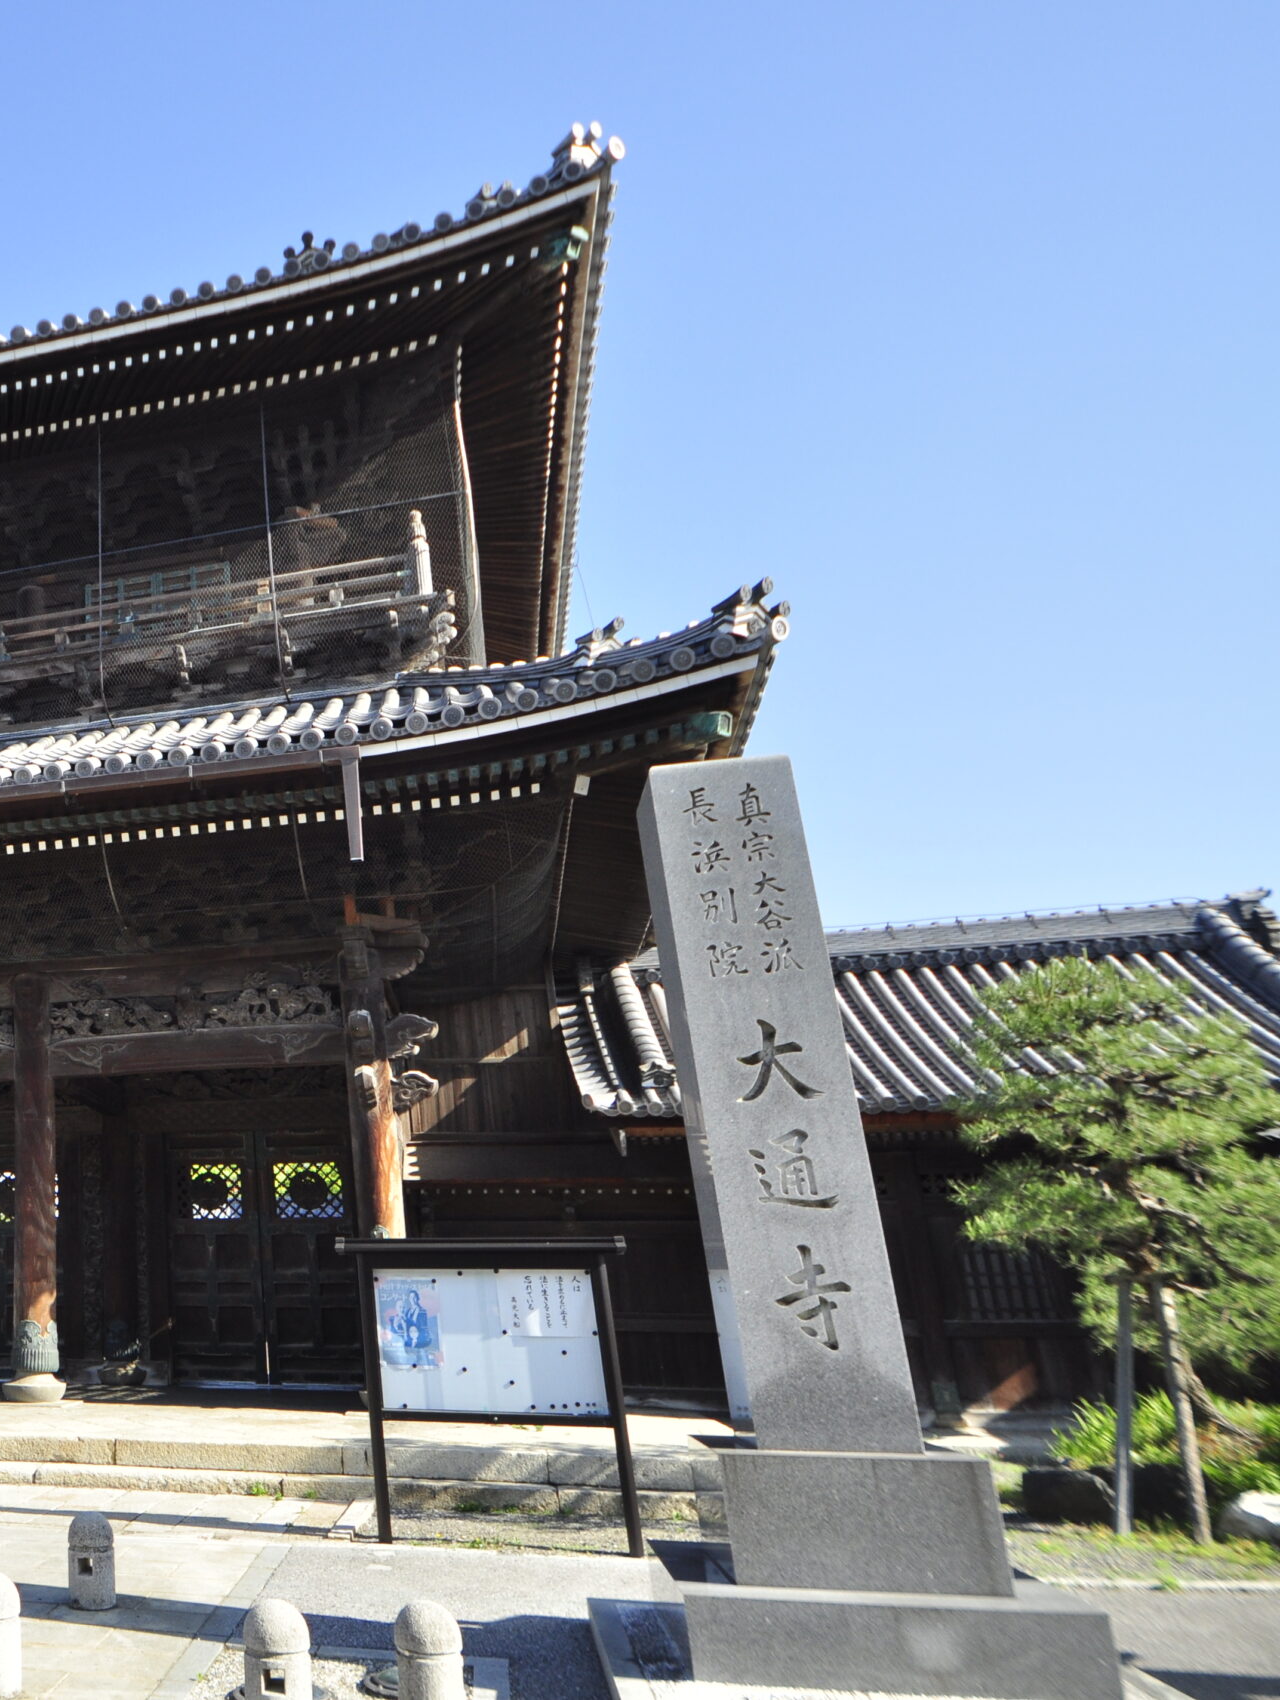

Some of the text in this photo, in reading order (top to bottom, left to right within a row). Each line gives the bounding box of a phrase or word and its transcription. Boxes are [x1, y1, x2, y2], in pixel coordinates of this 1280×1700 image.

[682, 788, 748, 977] 長浜別院
[735, 782, 804, 974] 真宗大谷派
[736, 1018, 851, 1351] 大通寺
